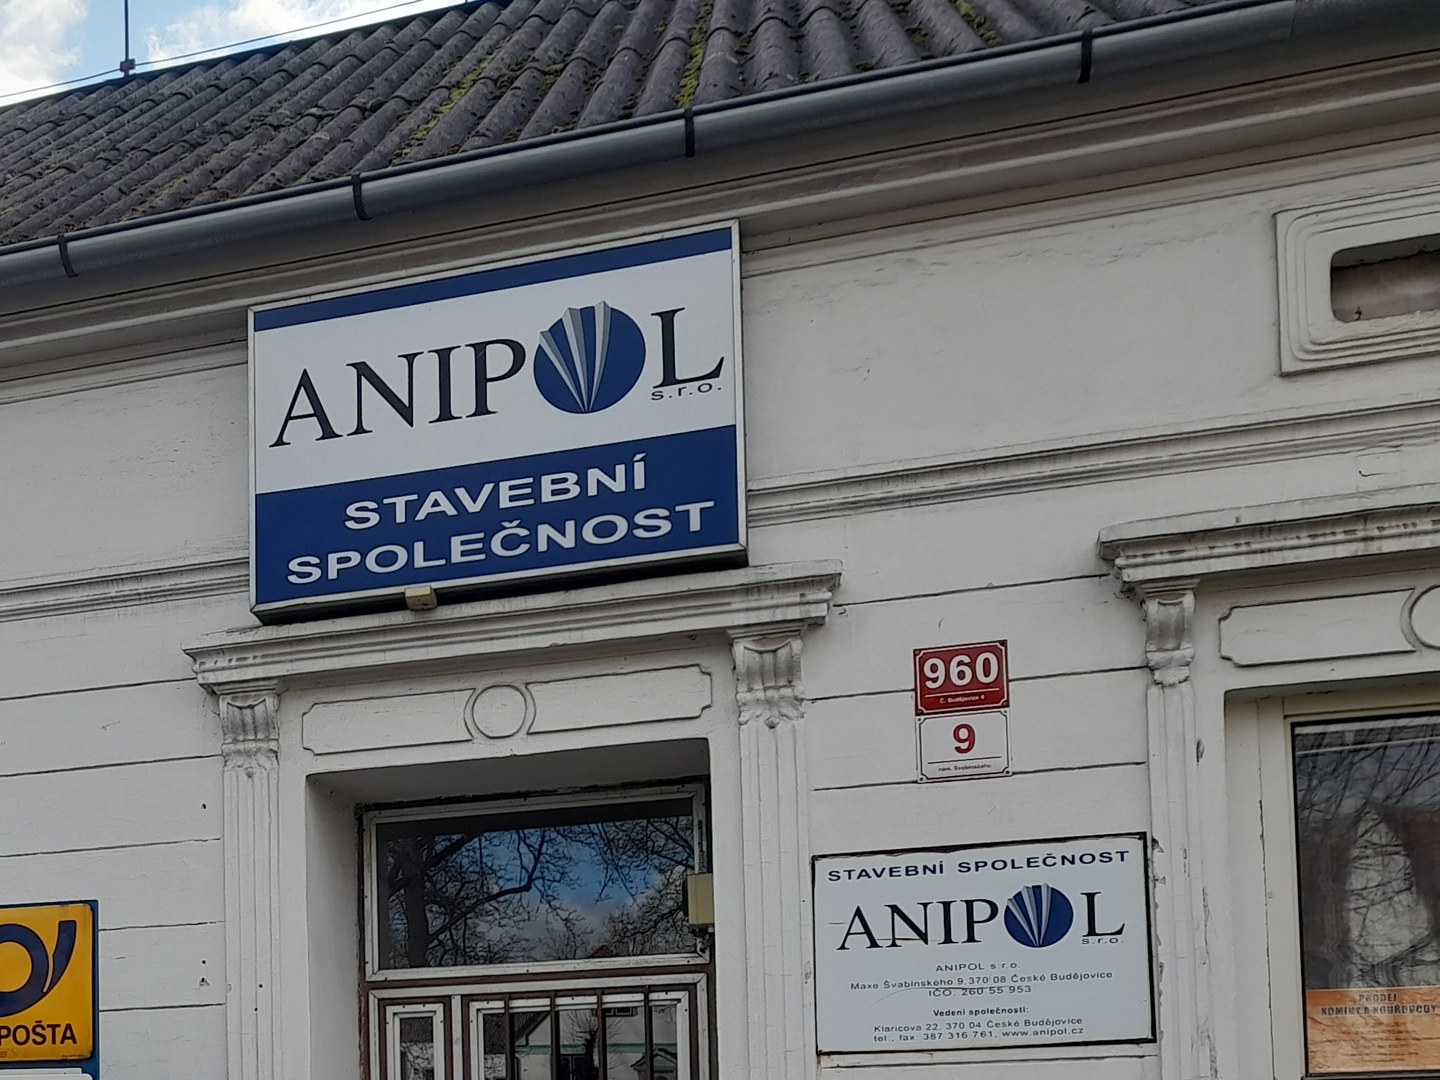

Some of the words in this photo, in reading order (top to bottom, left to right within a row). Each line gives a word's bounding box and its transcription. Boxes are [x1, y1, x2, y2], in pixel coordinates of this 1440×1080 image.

[268, 300, 724, 448] ANIPOL
[650, 382, 722, 401] s.r.o.
[343, 452, 648, 531] STAVEBNÍ
[286, 500, 715, 586] SPOLEČNOST
[923, 651, 1000, 690] 960
[952, 723, 976, 754] 9
[827, 860, 945, 882] STAVEBNÍ
[957, 850, 1130, 874] SPOLEČNOST
[836, 882, 1126, 951] ANIPOL
[1081, 937, 1124, 945] s.r.o.
[935, 963, 985, 973] ANIPOL
[990, 962, 1020, 970] s.r.o.
[850, 982, 879, 991] Maxe
[1010, 973, 1046, 983] České
[1050, 971, 1113, 982] Budějovice
[928, 987, 956, 997] IČO:
[961, 987, 984, 996] 260
[988, 985, 1004, 995] 55
[1008, 985, 1032, 993] 953
[933, 1007, 966, 1017] Vedení
[968, 1005, 1029, 1017] společnosti:
[946, 1021, 965, 1030] 370
[969, 1021, 982, 1029] 04
[986, 1019, 1020, 1029] České
[1024, 1017, 1083, 1027] Budějovice
[923, 1032, 943, 1041] 387
[948, 1031, 968, 1039] 316
[1002, 1027, 1084, 1037] www.anipol.cz
